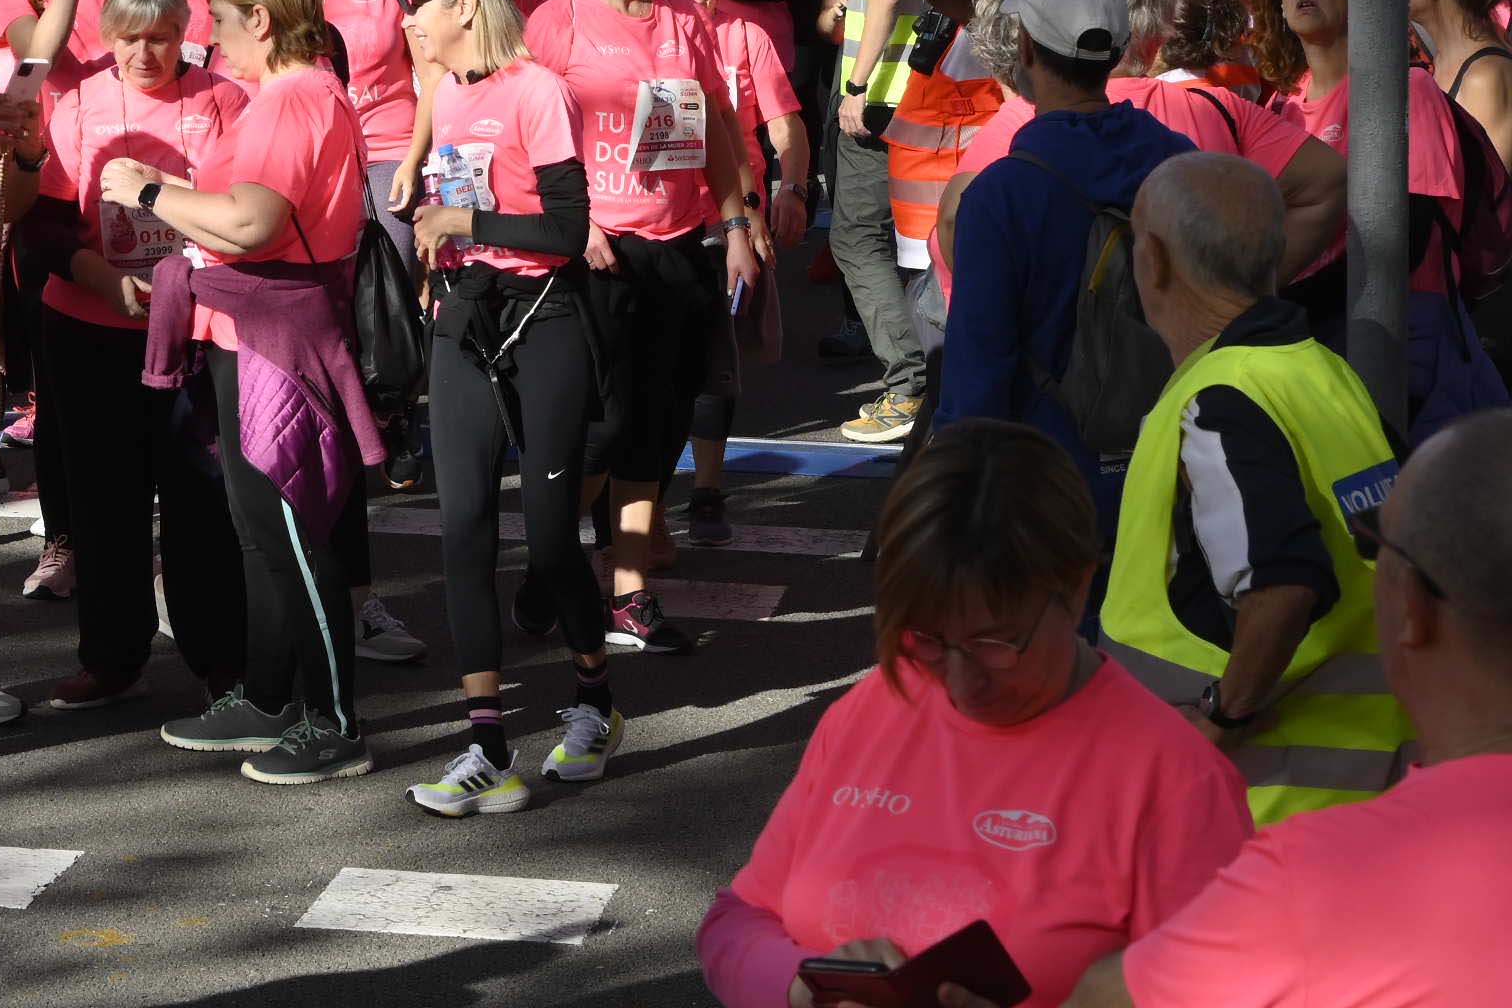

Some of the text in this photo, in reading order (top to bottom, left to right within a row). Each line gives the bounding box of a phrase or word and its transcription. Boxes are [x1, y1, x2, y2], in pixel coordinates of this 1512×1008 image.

[594, 111, 626, 134] TU
[593, 170, 668, 196] SUMA
[138, 228, 176, 244] 016
[979, 818, 1049, 842] ASTURIANA
